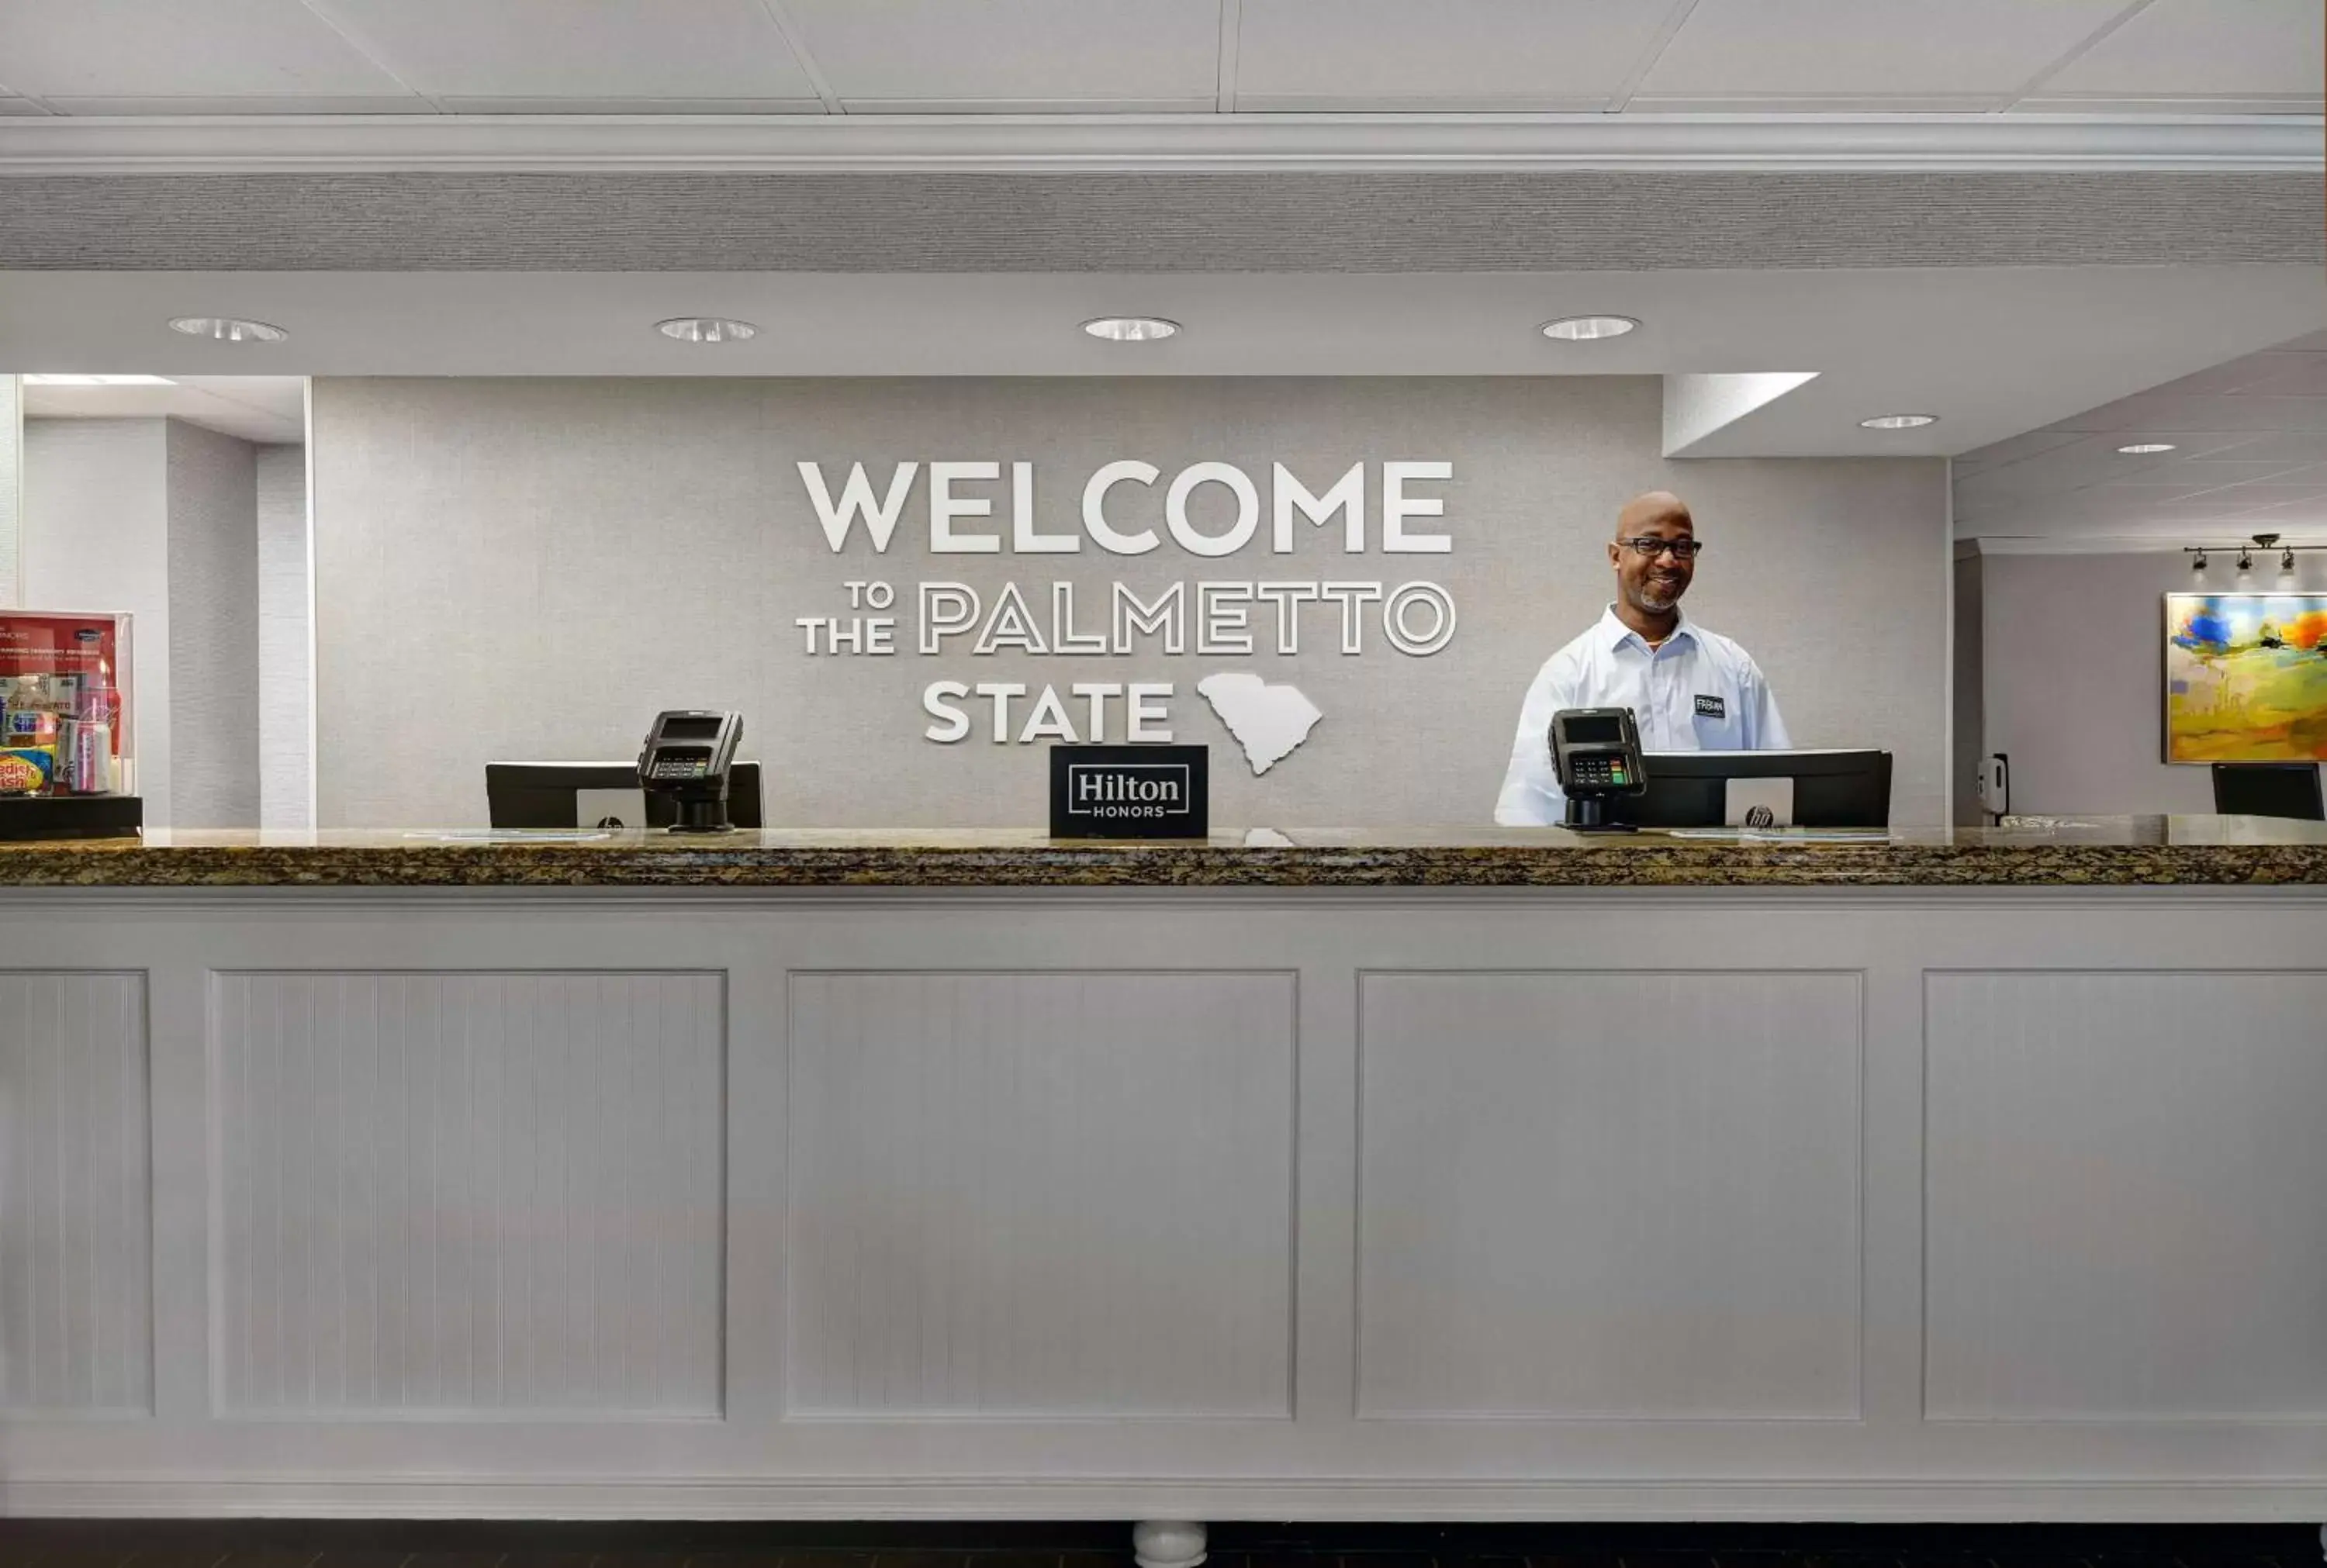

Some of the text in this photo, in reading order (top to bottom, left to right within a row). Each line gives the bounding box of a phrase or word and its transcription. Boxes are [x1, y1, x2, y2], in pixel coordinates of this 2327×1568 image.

[797, 460, 1453, 556] WELCOME
[796, 580, 1456, 654] THE PALMETTO
[843, 581, 894, 609] TO
[924, 681, 1174, 742] STATE
[1079, 774, 1179, 801] Hilton
[1094, 806, 1164, 817] HONORS
